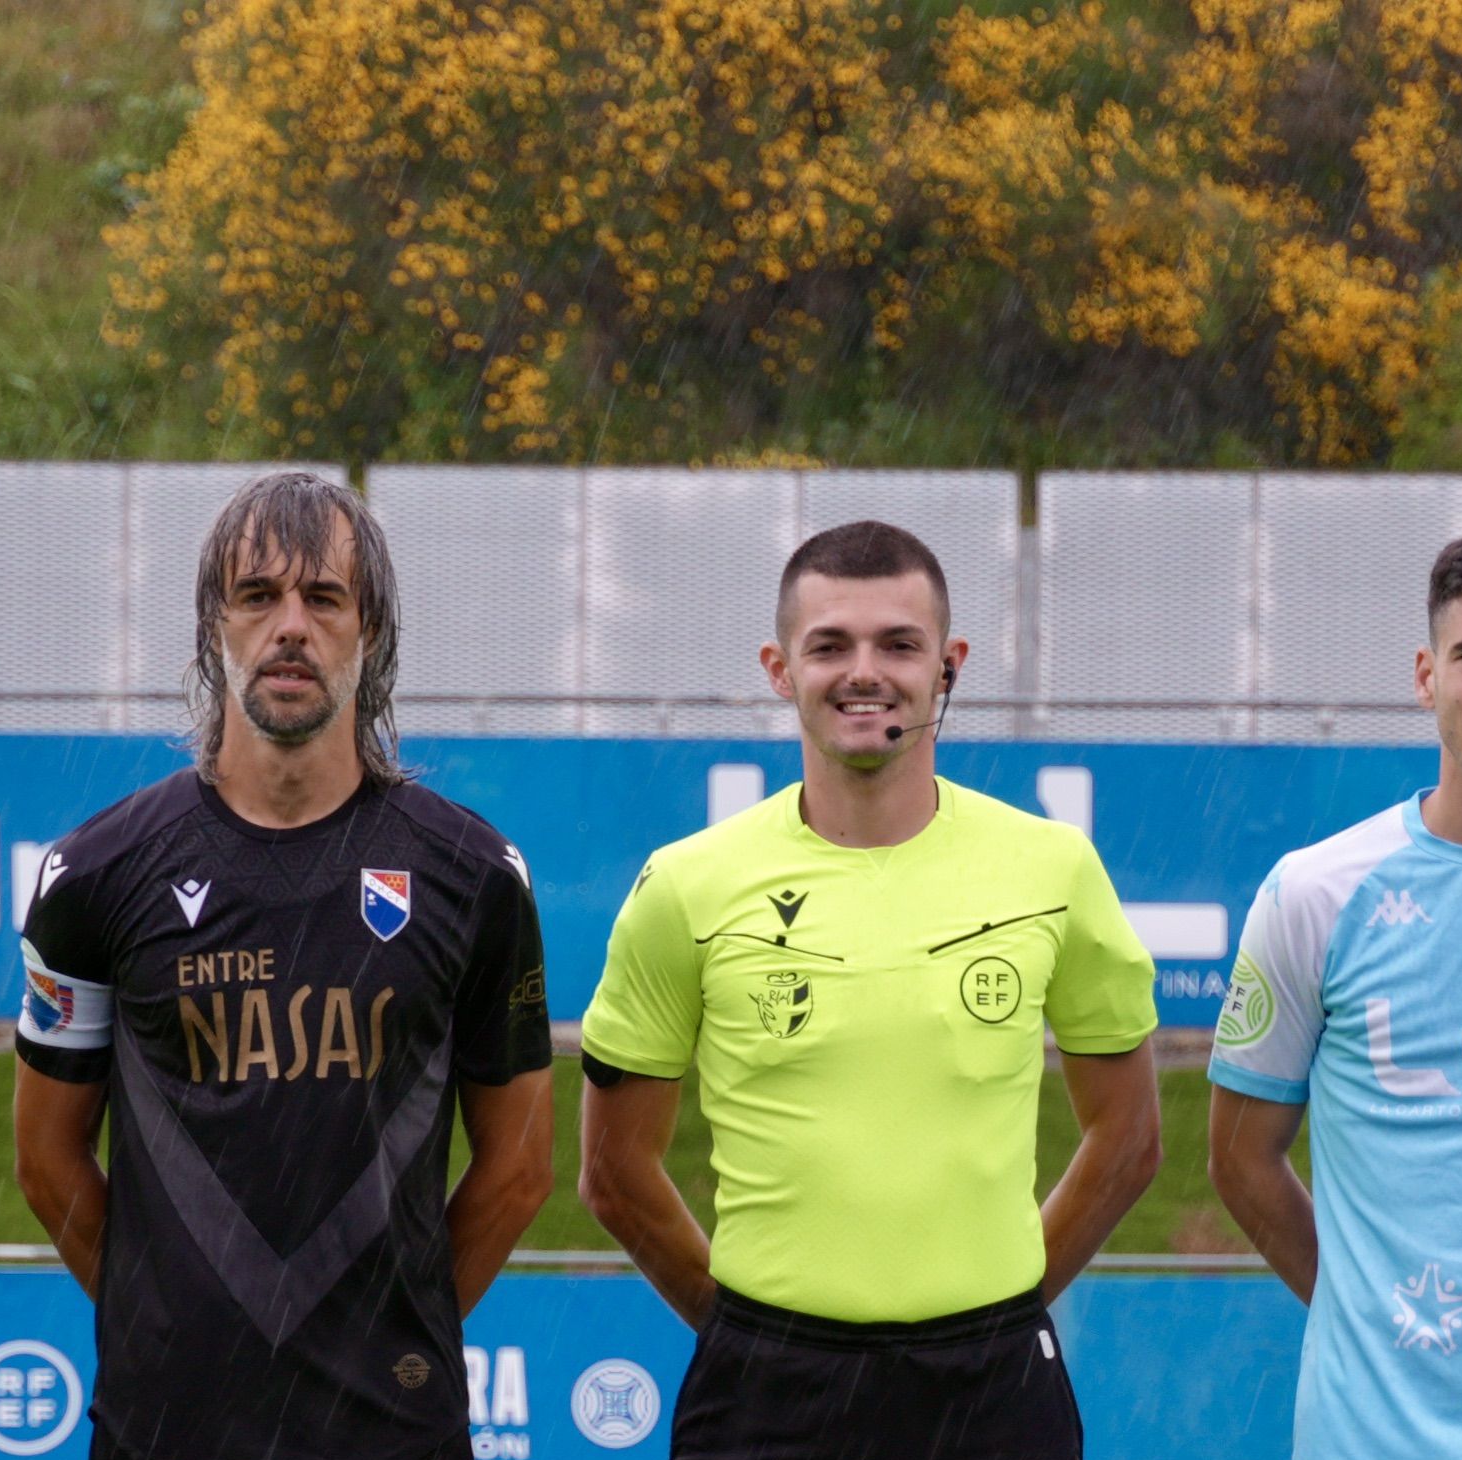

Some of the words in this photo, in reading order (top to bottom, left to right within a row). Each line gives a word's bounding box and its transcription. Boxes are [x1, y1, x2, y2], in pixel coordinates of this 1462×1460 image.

[178, 949, 275, 987] ENTRE
[1155, 969, 1228, 999] INA
[178, 984, 395, 1083] NASAS
[1370, 1103, 1390, 1114] LA
